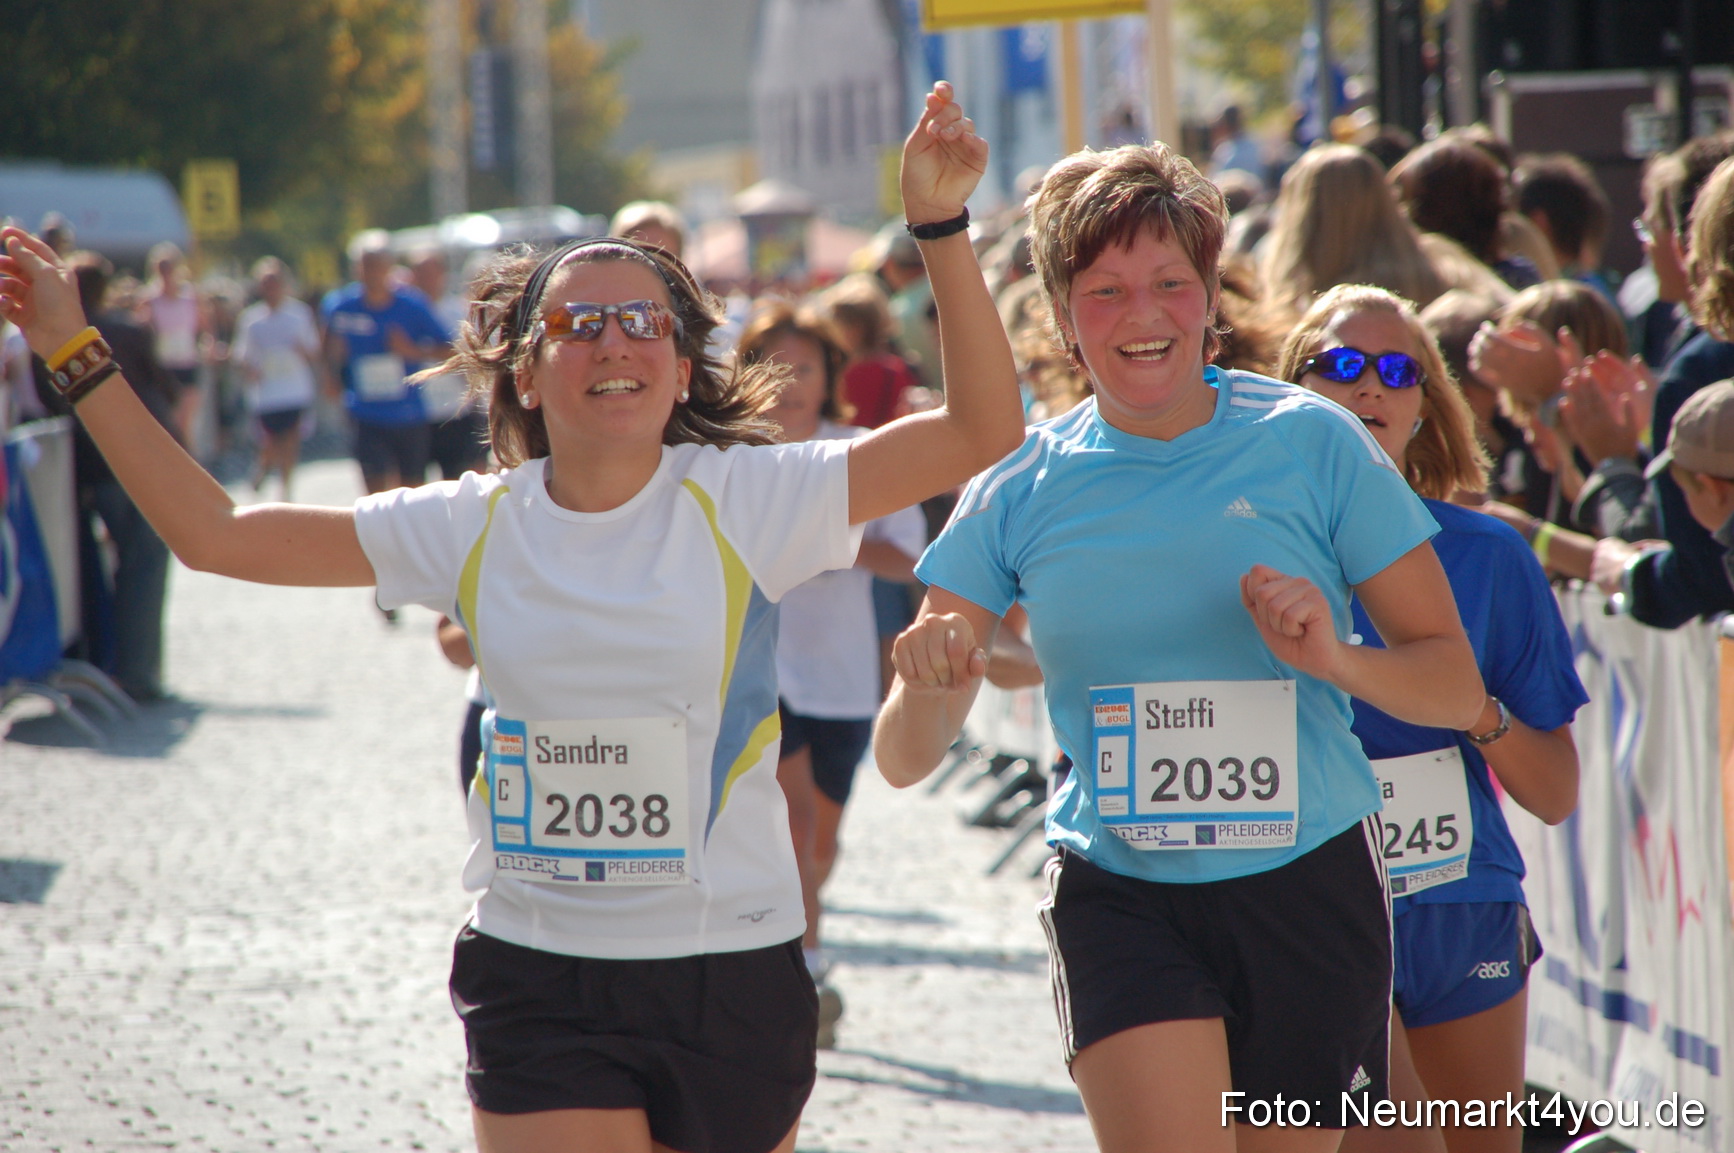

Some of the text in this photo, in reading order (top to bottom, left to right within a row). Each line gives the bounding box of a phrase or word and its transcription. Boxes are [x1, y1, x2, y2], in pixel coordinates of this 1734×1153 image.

[1223, 509, 1258, 519] adidas
[1146, 697, 1214, 730] Steffi
[535, 735, 629, 765] Sandra
[1101, 751, 1112, 773] C
[498, 779, 509, 801] C
[1150, 756, 1280, 802] 2039
[544, 793, 671, 838] 2038
[1218, 823, 1294, 836] PFLEIDERER
[496, 854, 560, 874] BOCK
[608, 860, 685, 874] PFLEIDERER
[1409, 861, 1465, 885] PFLEIDERER
[1350, 1076, 1371, 1093] adidas
